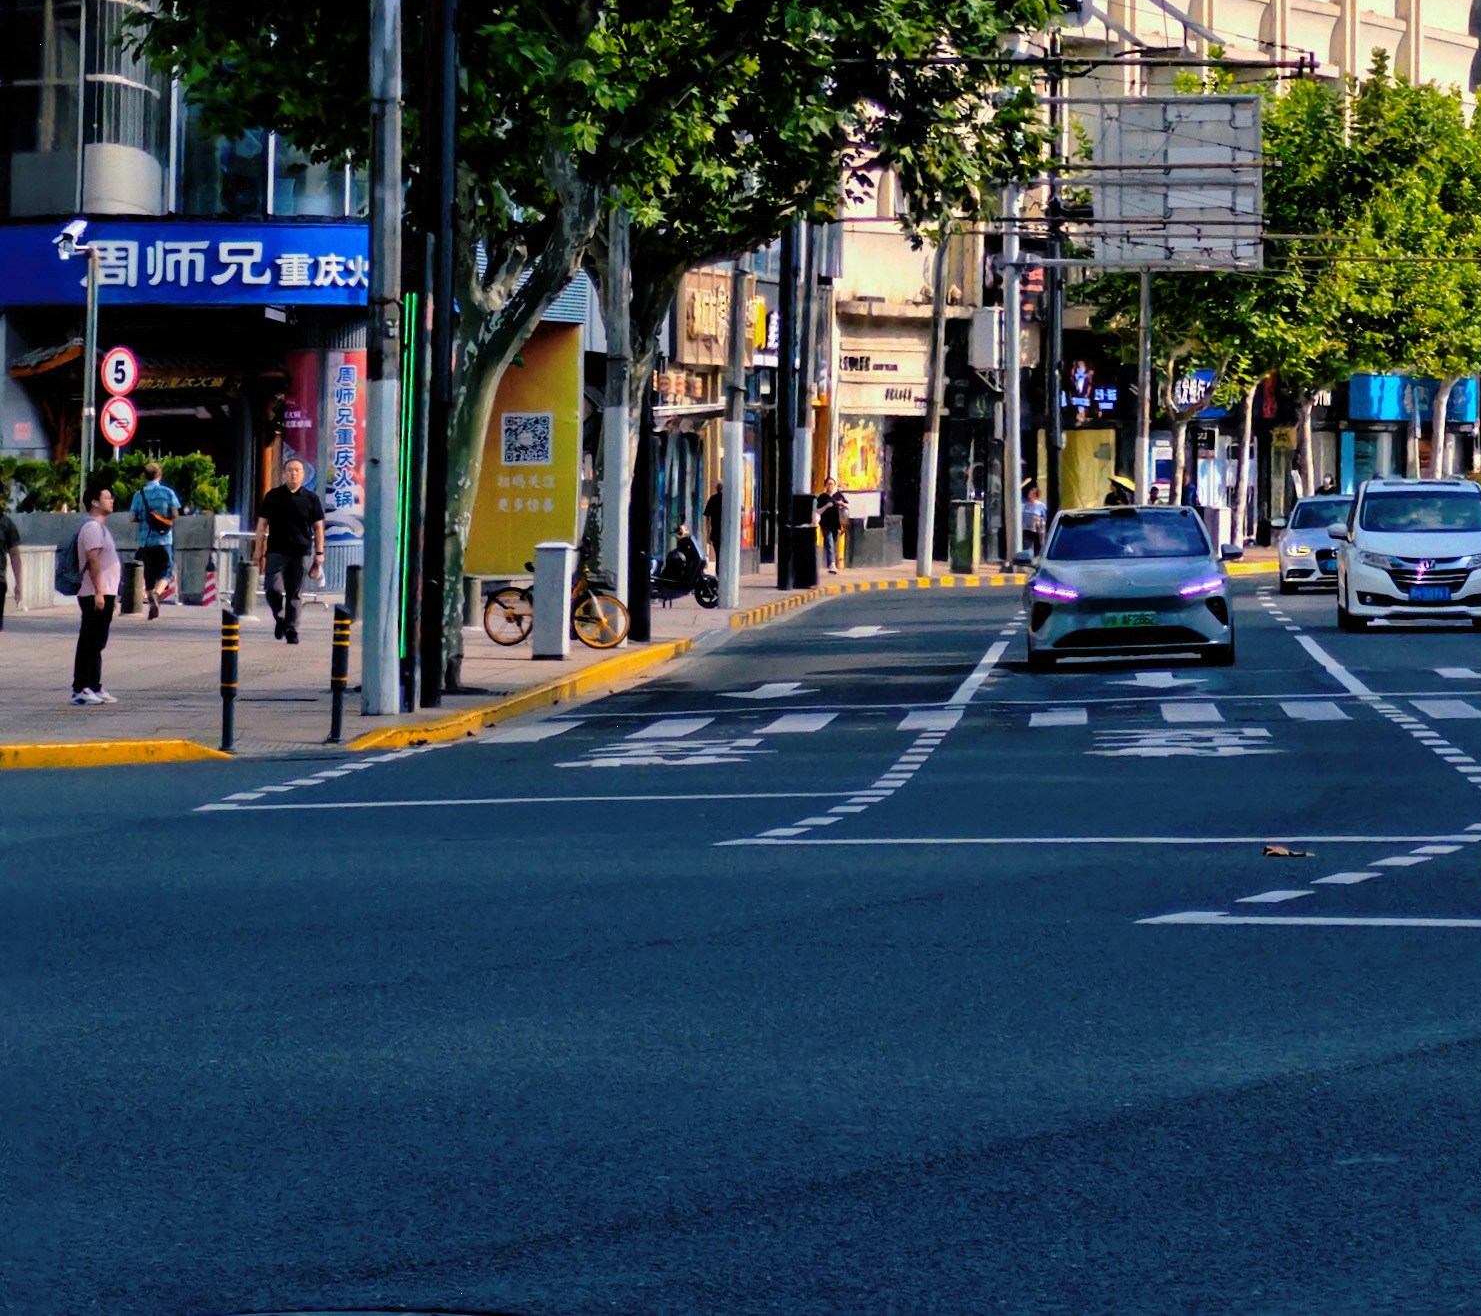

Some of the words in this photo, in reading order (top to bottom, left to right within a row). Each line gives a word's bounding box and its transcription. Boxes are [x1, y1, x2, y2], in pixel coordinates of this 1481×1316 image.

[113, 360, 126, 384] 5
[334, 365, 357, 509] 周师兄重庆火锅
